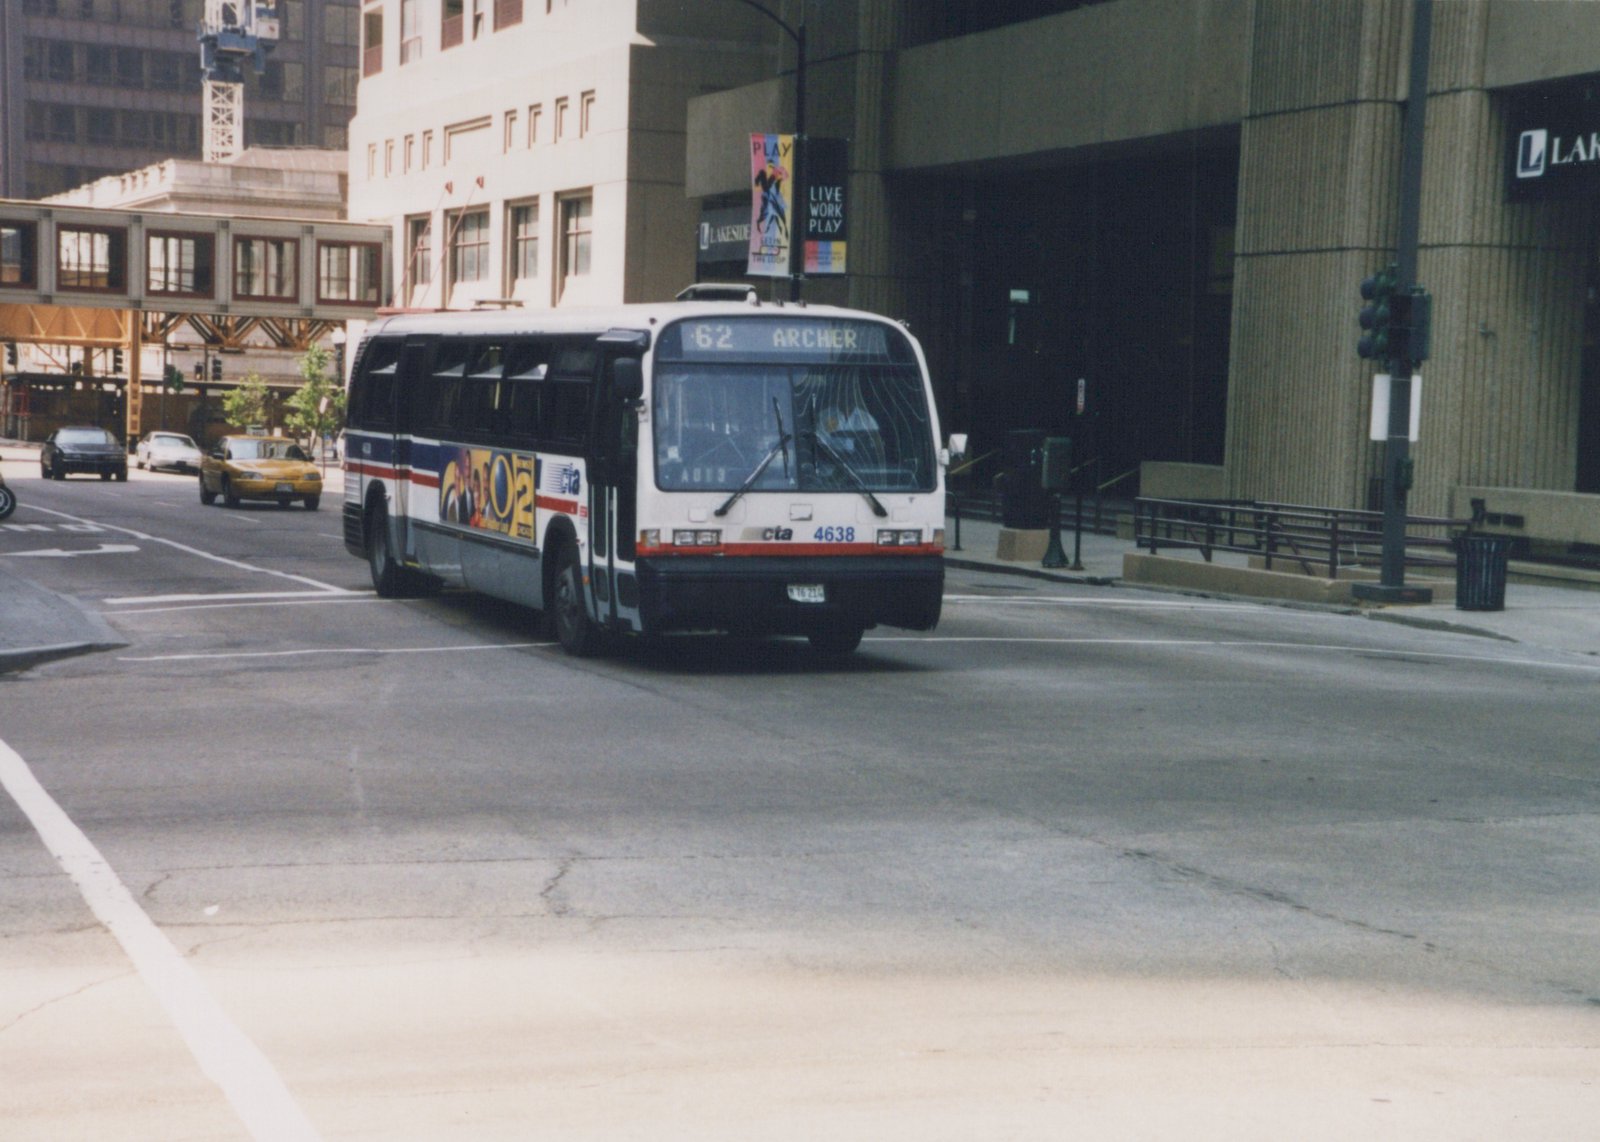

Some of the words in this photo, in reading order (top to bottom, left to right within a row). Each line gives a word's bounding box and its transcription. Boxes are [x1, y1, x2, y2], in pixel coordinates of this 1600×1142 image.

[753, 142, 792, 157] PLAY
[810, 186, 843, 202] LIVE
[809, 203, 843, 218] WORK
[809, 219, 842, 233] PLAY
[695, 324, 734, 348] 62
[772, 328, 858, 348] ARCHER
[762, 525, 793, 541] cta
[814, 527, 856, 542] 4638
